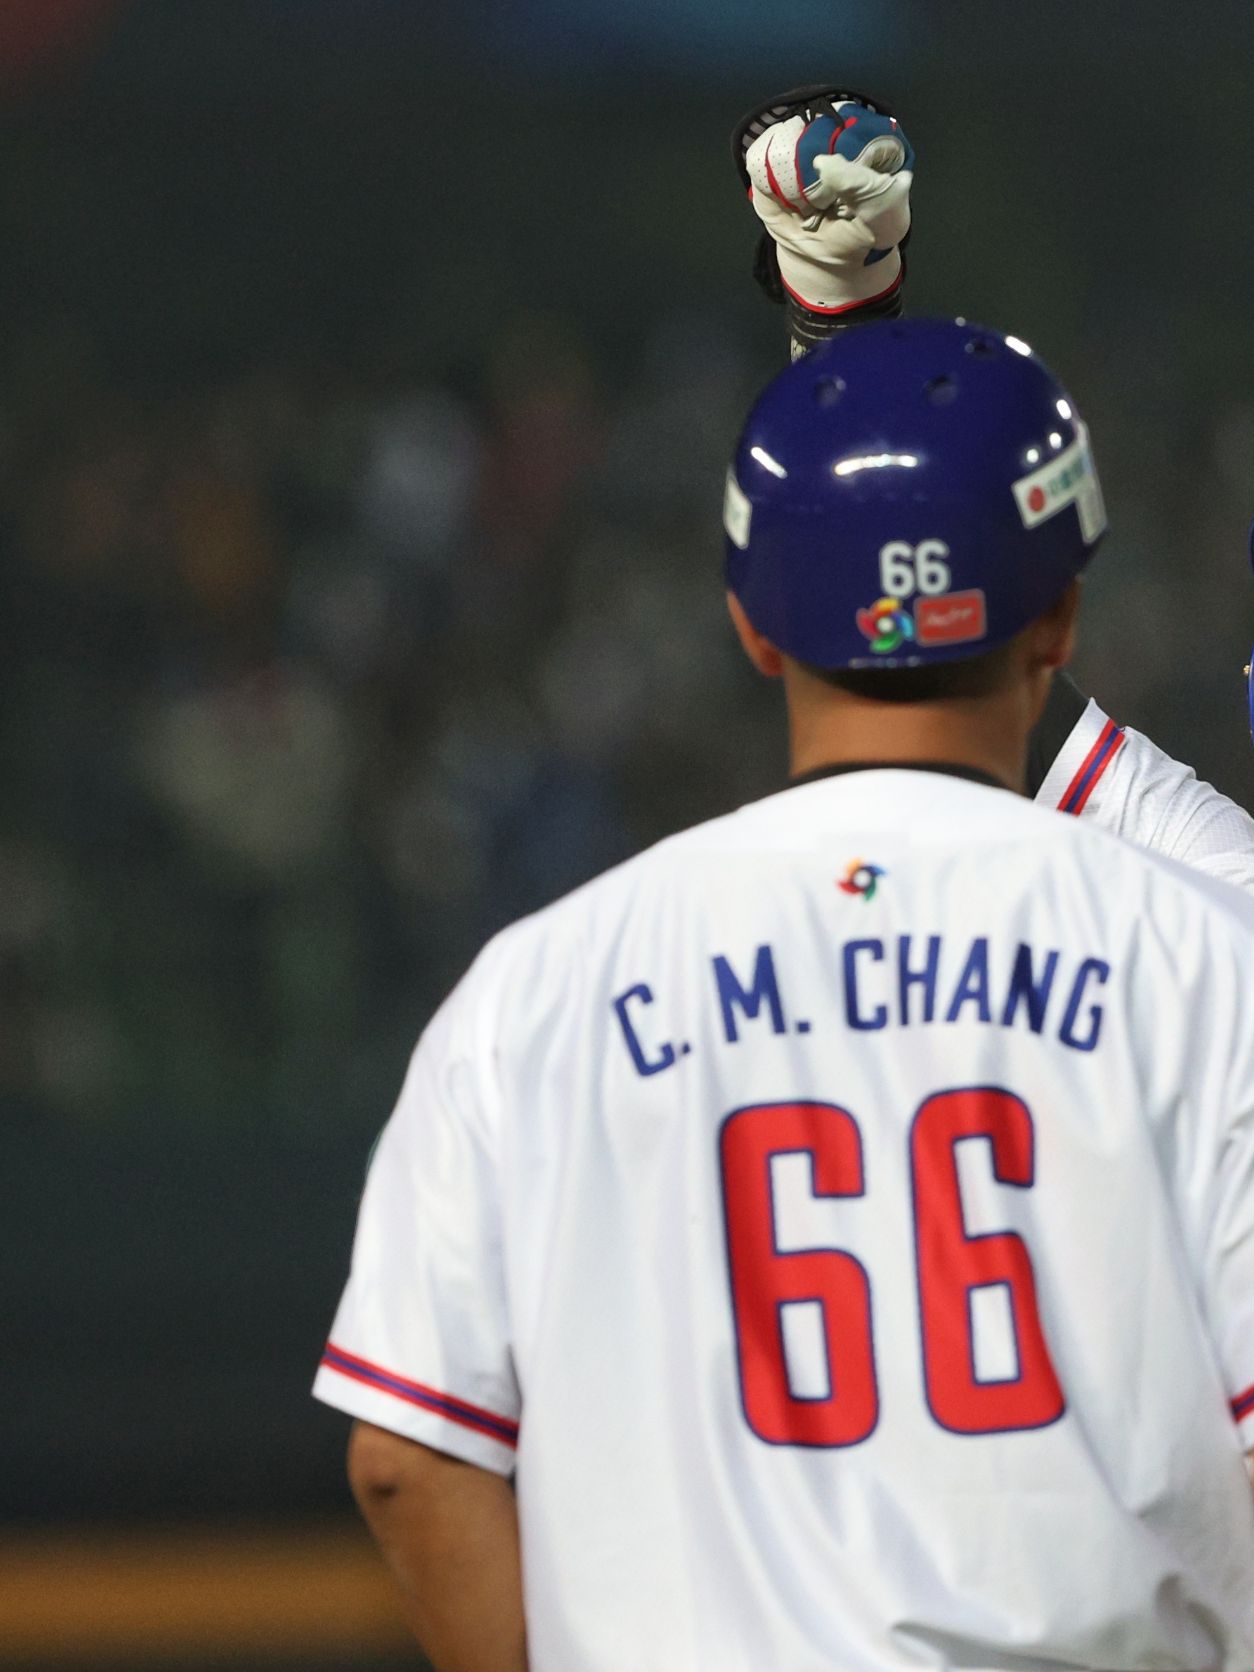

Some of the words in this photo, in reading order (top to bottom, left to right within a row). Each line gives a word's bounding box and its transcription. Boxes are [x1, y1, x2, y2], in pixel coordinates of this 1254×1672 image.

[879, 538, 950, 597] 66
[612, 983, 692, 1078] C.
[711, 942, 811, 1044] M.
[842, 934, 1111, 1053] CHANG
[718, 1085, 1067, 1450] 66
